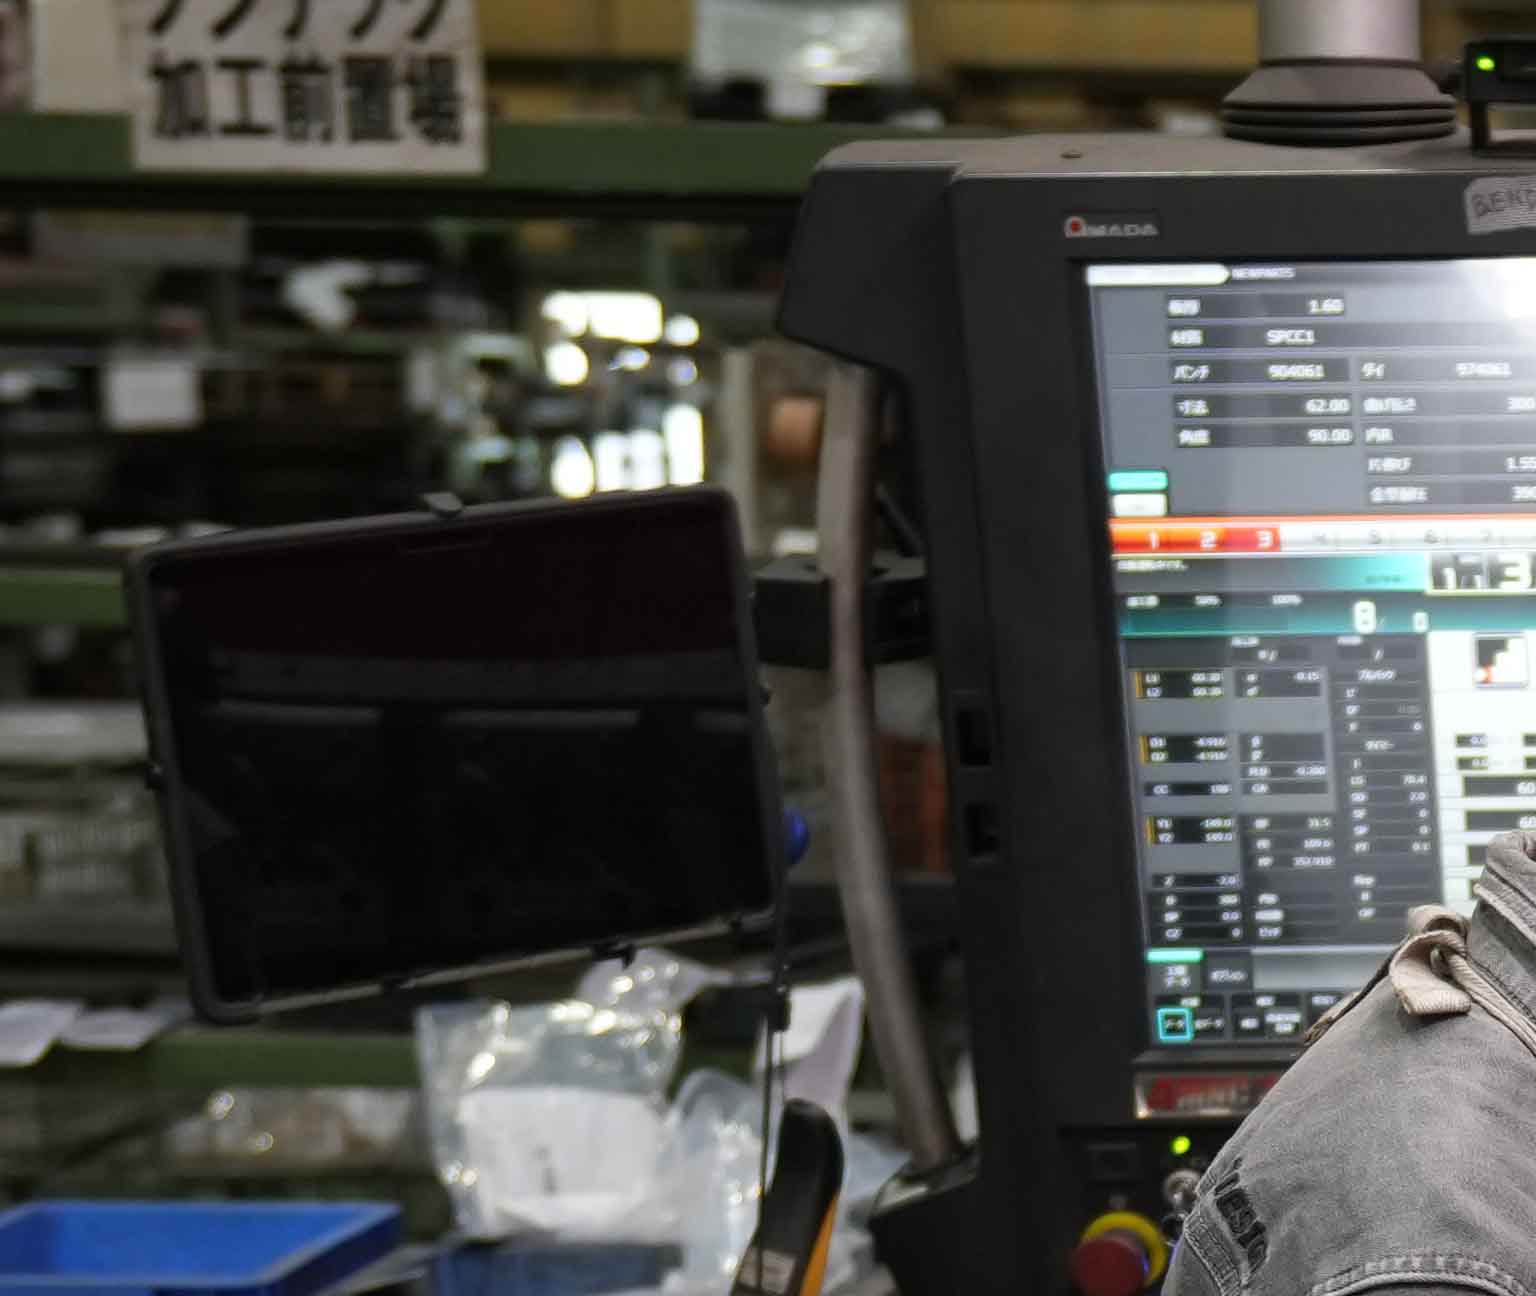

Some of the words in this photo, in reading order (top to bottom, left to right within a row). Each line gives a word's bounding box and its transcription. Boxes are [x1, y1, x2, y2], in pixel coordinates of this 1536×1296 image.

[150, 49, 465, 144] 加工前置場
[1200, 530, 1218, 549] 2
[1256, 530, 1273, 549] 3
